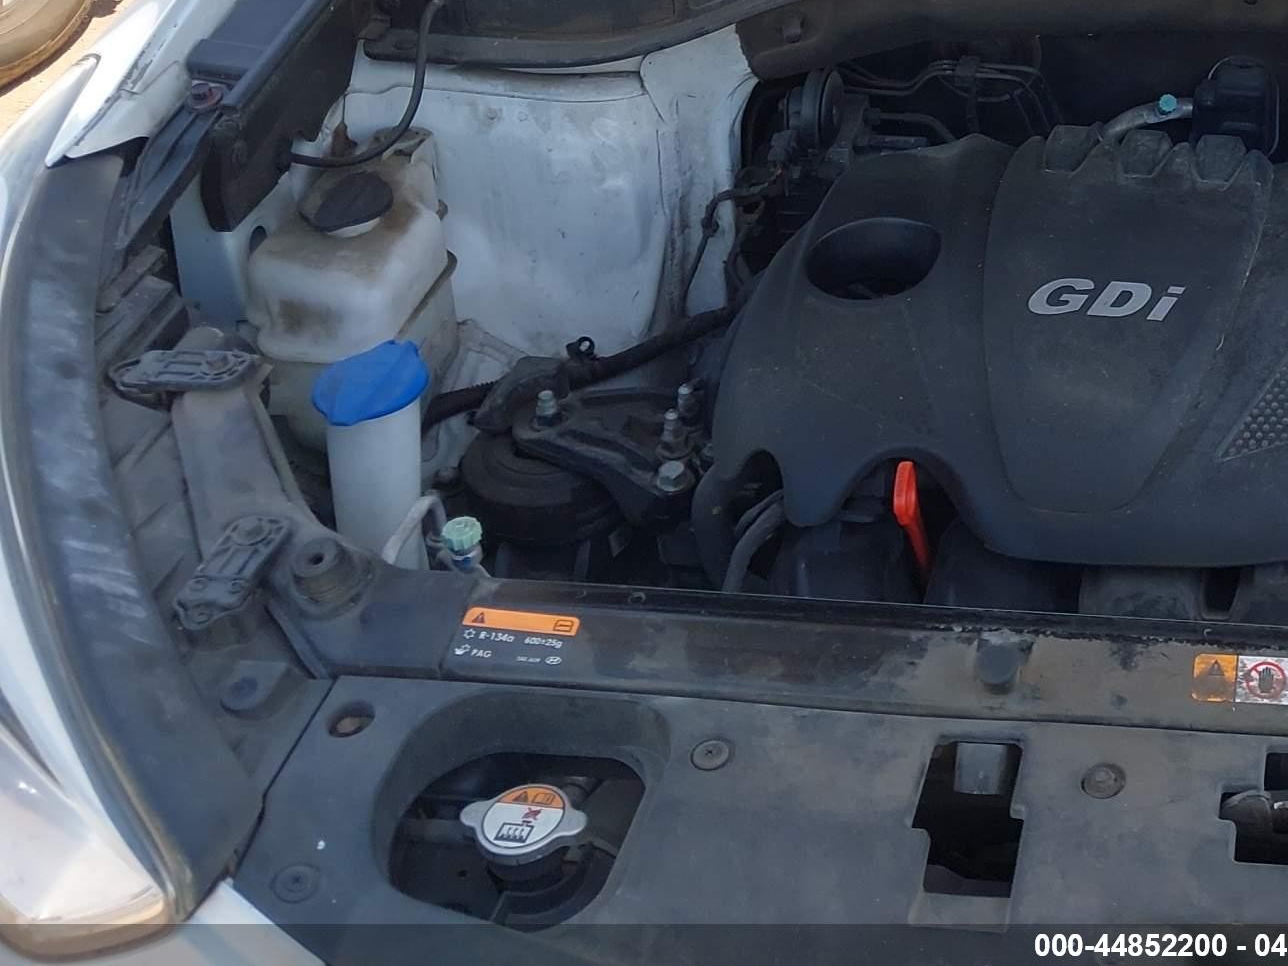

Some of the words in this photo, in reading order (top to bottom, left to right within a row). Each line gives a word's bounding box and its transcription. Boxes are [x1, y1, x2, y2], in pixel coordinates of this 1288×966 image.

[1027, 277, 1187, 322] GDi
[478, 631, 516, 643] R-134a
[470, 648, 493, 658] PAG
